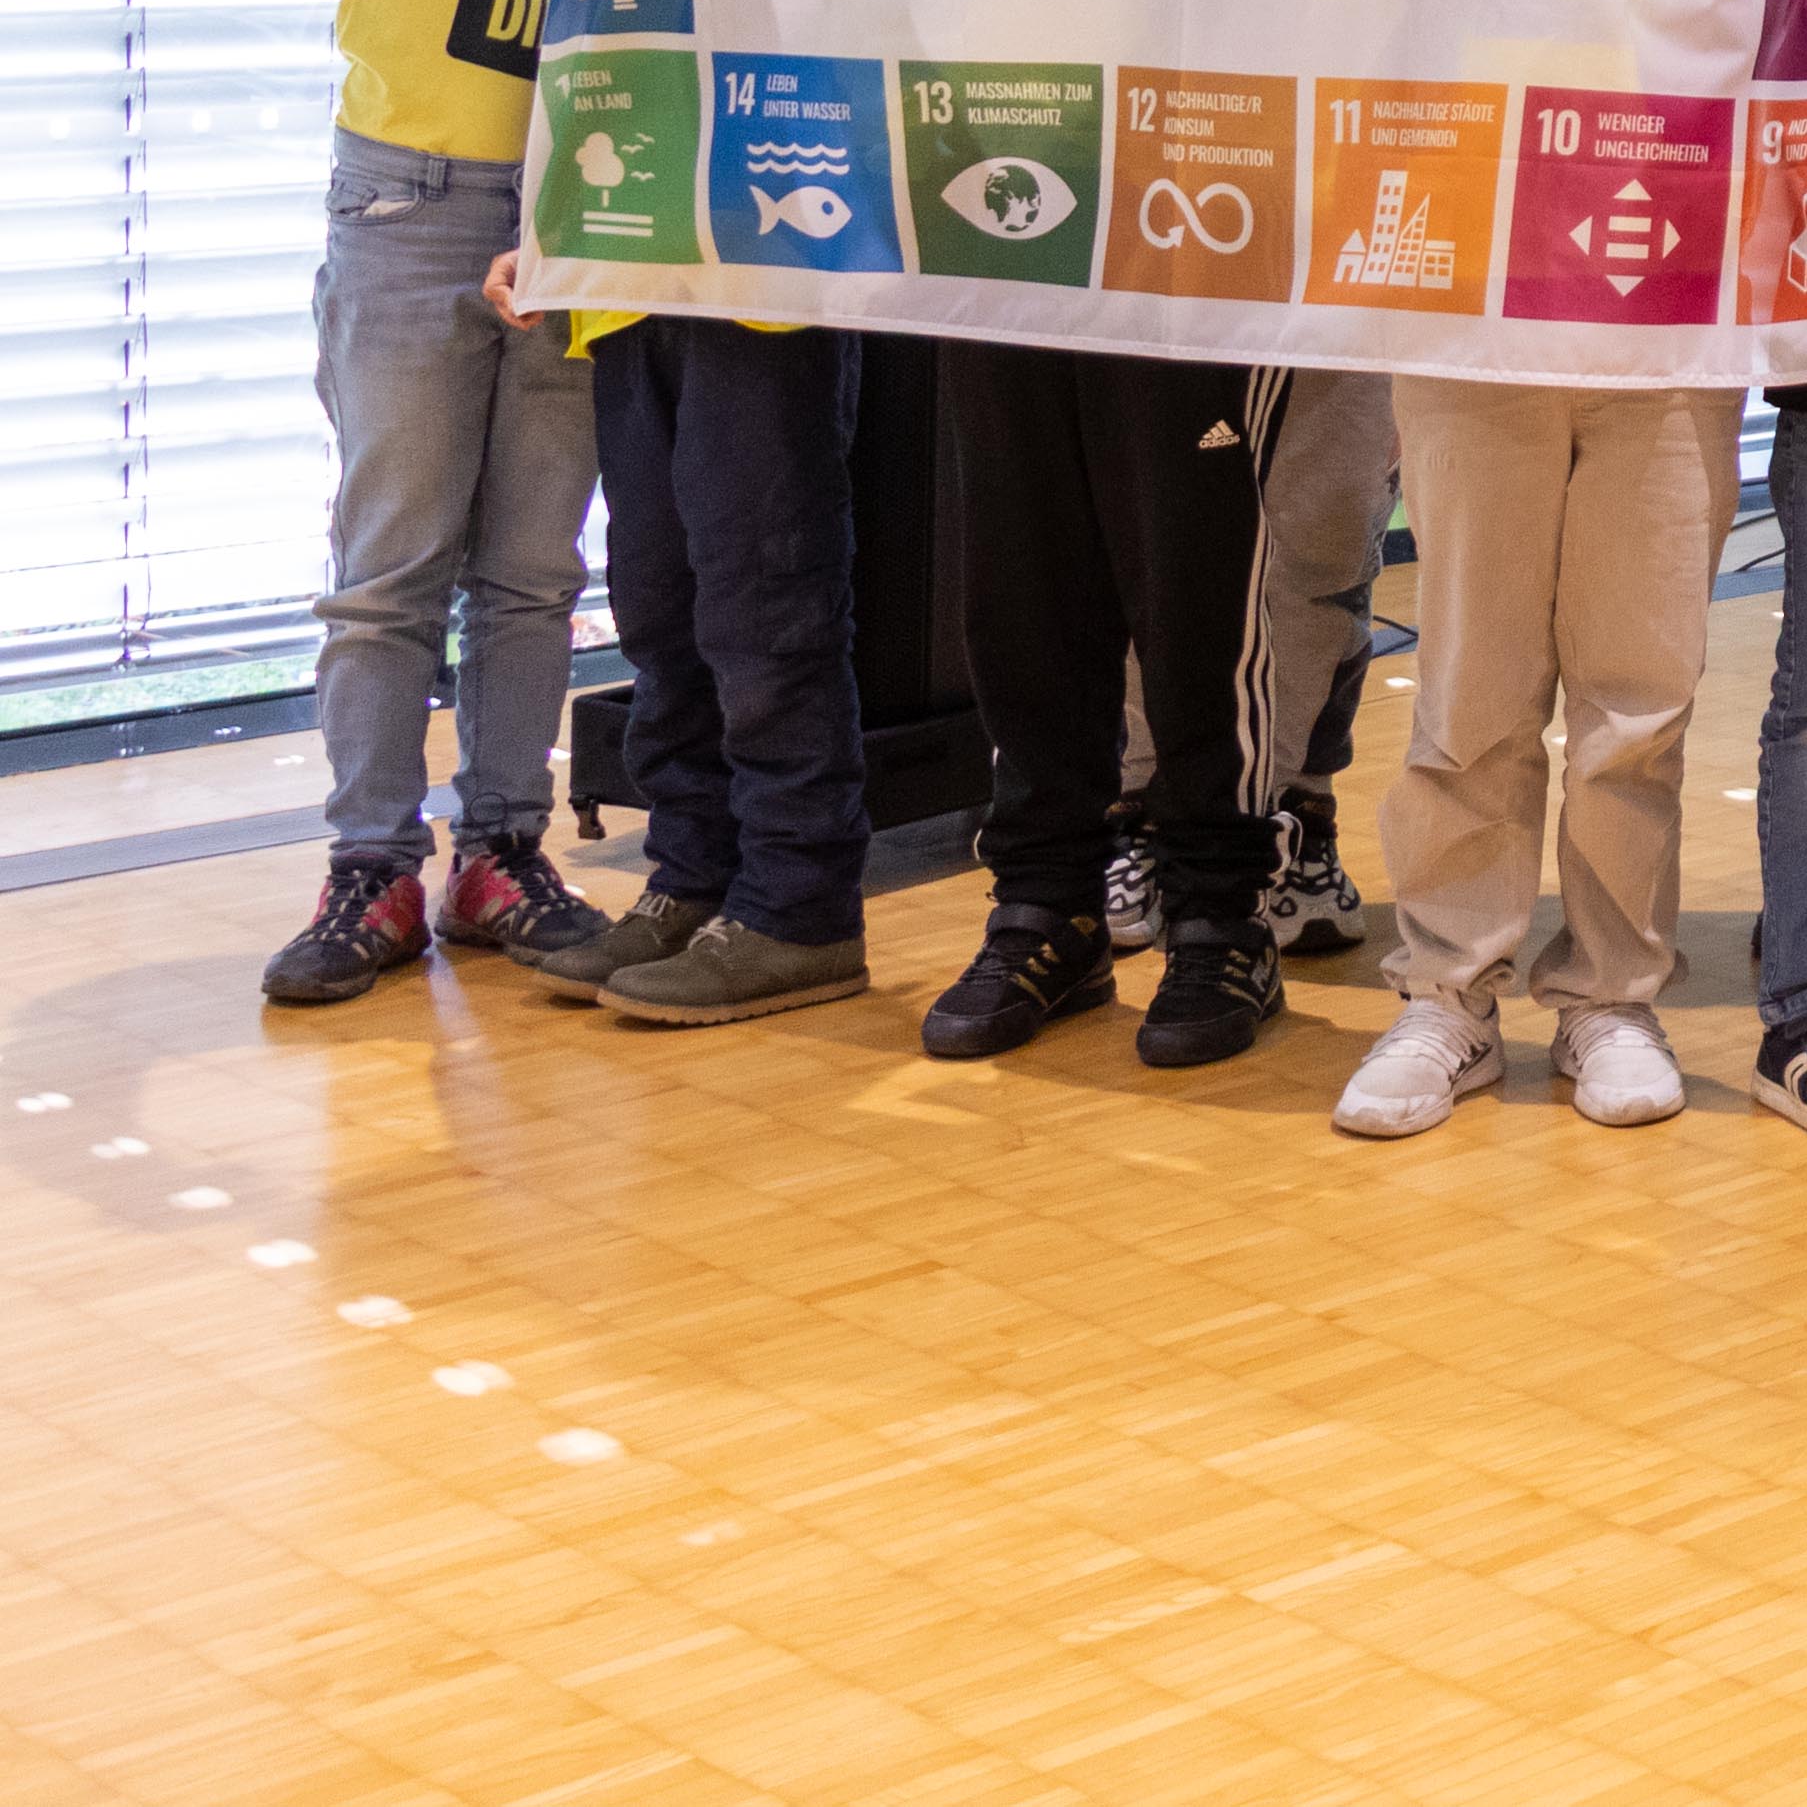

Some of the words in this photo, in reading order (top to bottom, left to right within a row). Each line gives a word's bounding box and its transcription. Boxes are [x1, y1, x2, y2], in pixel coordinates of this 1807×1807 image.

[572, 70, 612, 89] LEBEN
[767, 74, 798, 92] LEBEN
[574, 96, 594, 112] AN
[597, 92, 633, 112] LAND
[725, 71, 756, 116] 14
[913, 81, 953, 125] 13
[966, 81, 1061, 102] MASSNAHMEN
[1064, 84, 1093, 102] ZUM
[1166, 90, 1262, 114] NACHHALTIGE/R
[763, 99, 800, 118] UNTER
[802, 102, 851, 121] WASSER
[967, 107, 1062, 126] KLIMASCHUTZ
[1127, 87, 1158, 134] 12
[1329, 98, 1361, 144] 11
[1373, 100, 1450, 122] NACHHALTIGE
[1450, 99, 1495, 123] STÄDTE
[1164, 116, 1215, 138] KONSUM
[1537, 108, 1581, 156] 10
[1598, 111, 1665, 134] WENIGER
[1371, 128, 1397, 145] UND
[1400, 129, 1458, 148] GEMEINDEN
[1762, 120, 1783, 164] 9
[1163, 143, 1185, 162] UND
[1189, 146, 1274, 169] PRODUKTION
[1595, 139, 1709, 163] UNGLEICHHEITEN
[1786, 144, 1807, 161] UND
